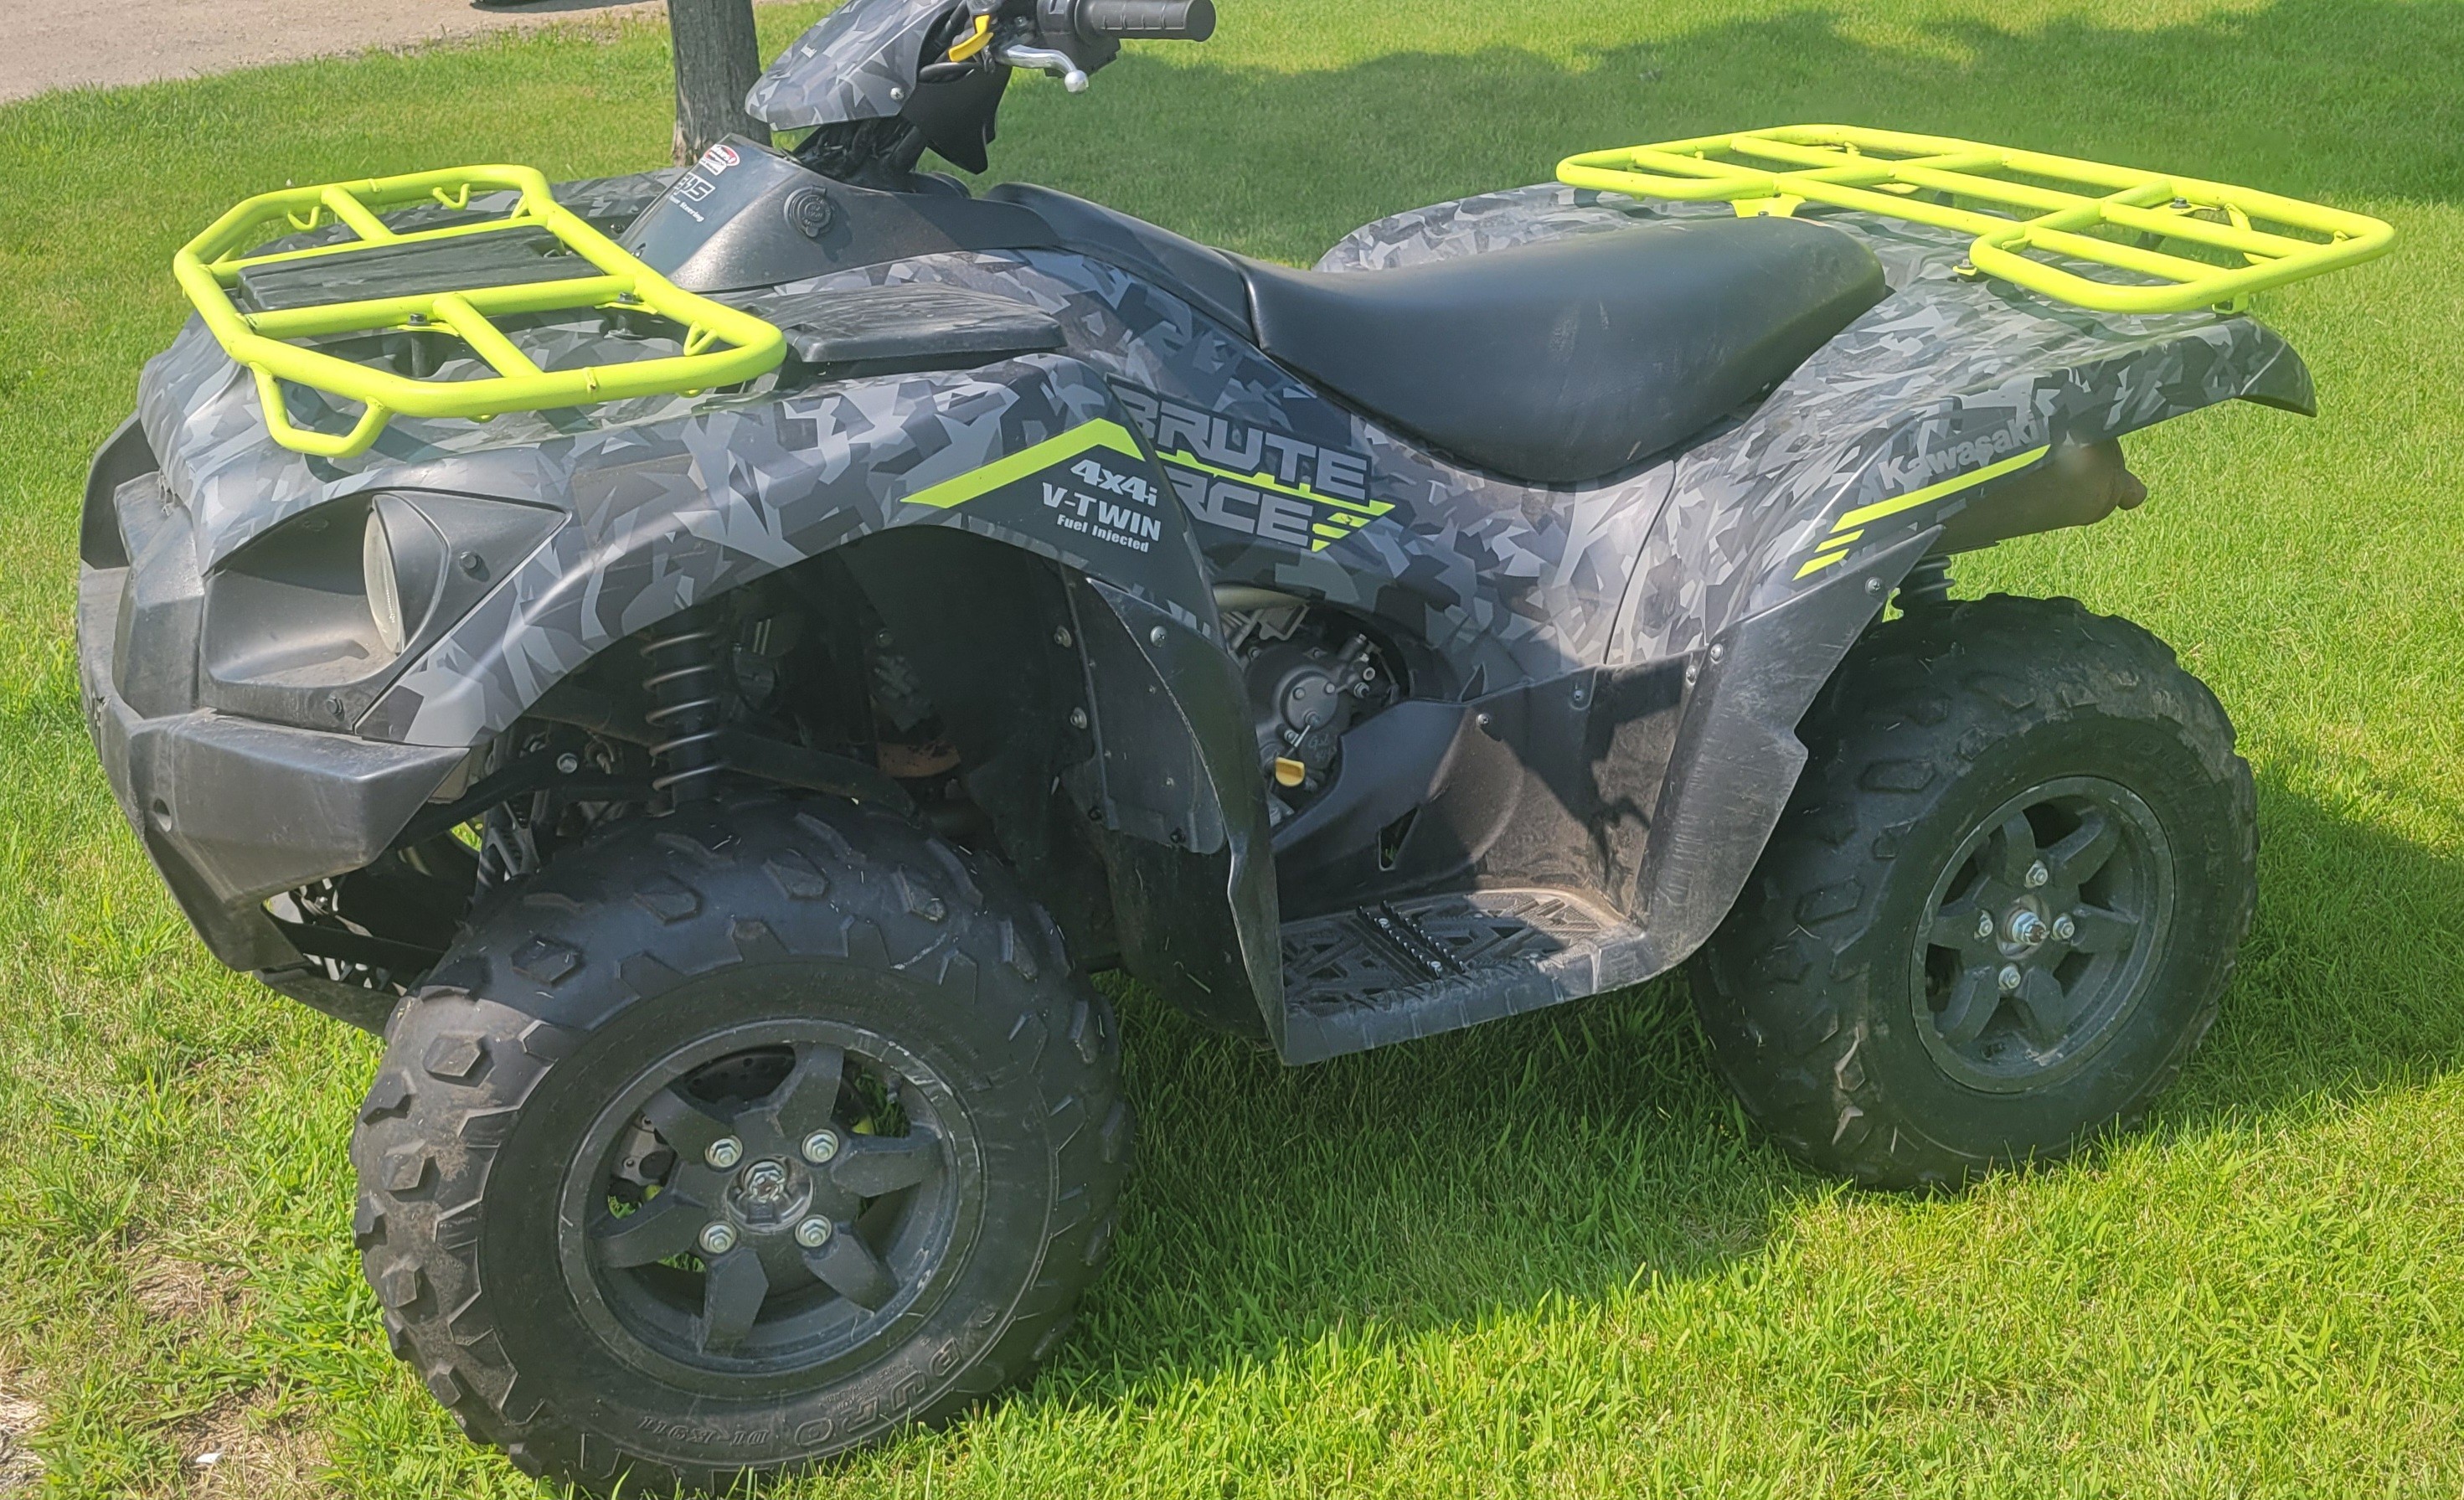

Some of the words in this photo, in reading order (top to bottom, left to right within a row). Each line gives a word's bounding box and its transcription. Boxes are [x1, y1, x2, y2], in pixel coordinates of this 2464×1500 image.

[679, 202, 704, 222] Steering
[1111, 384, 1367, 500] BRUTE
[1878, 413, 2040, 490] Kawasaki
[1042, 482, 1161, 541] V-TWIN
[1070, 459, 1157, 507] 4x4i
[1163, 466, 1313, 547] RCE
[1057, 513, 1088, 533] Fuel
[1091, 524, 1149, 553] Injected
[795, 1338, 962, 1447] DURO
